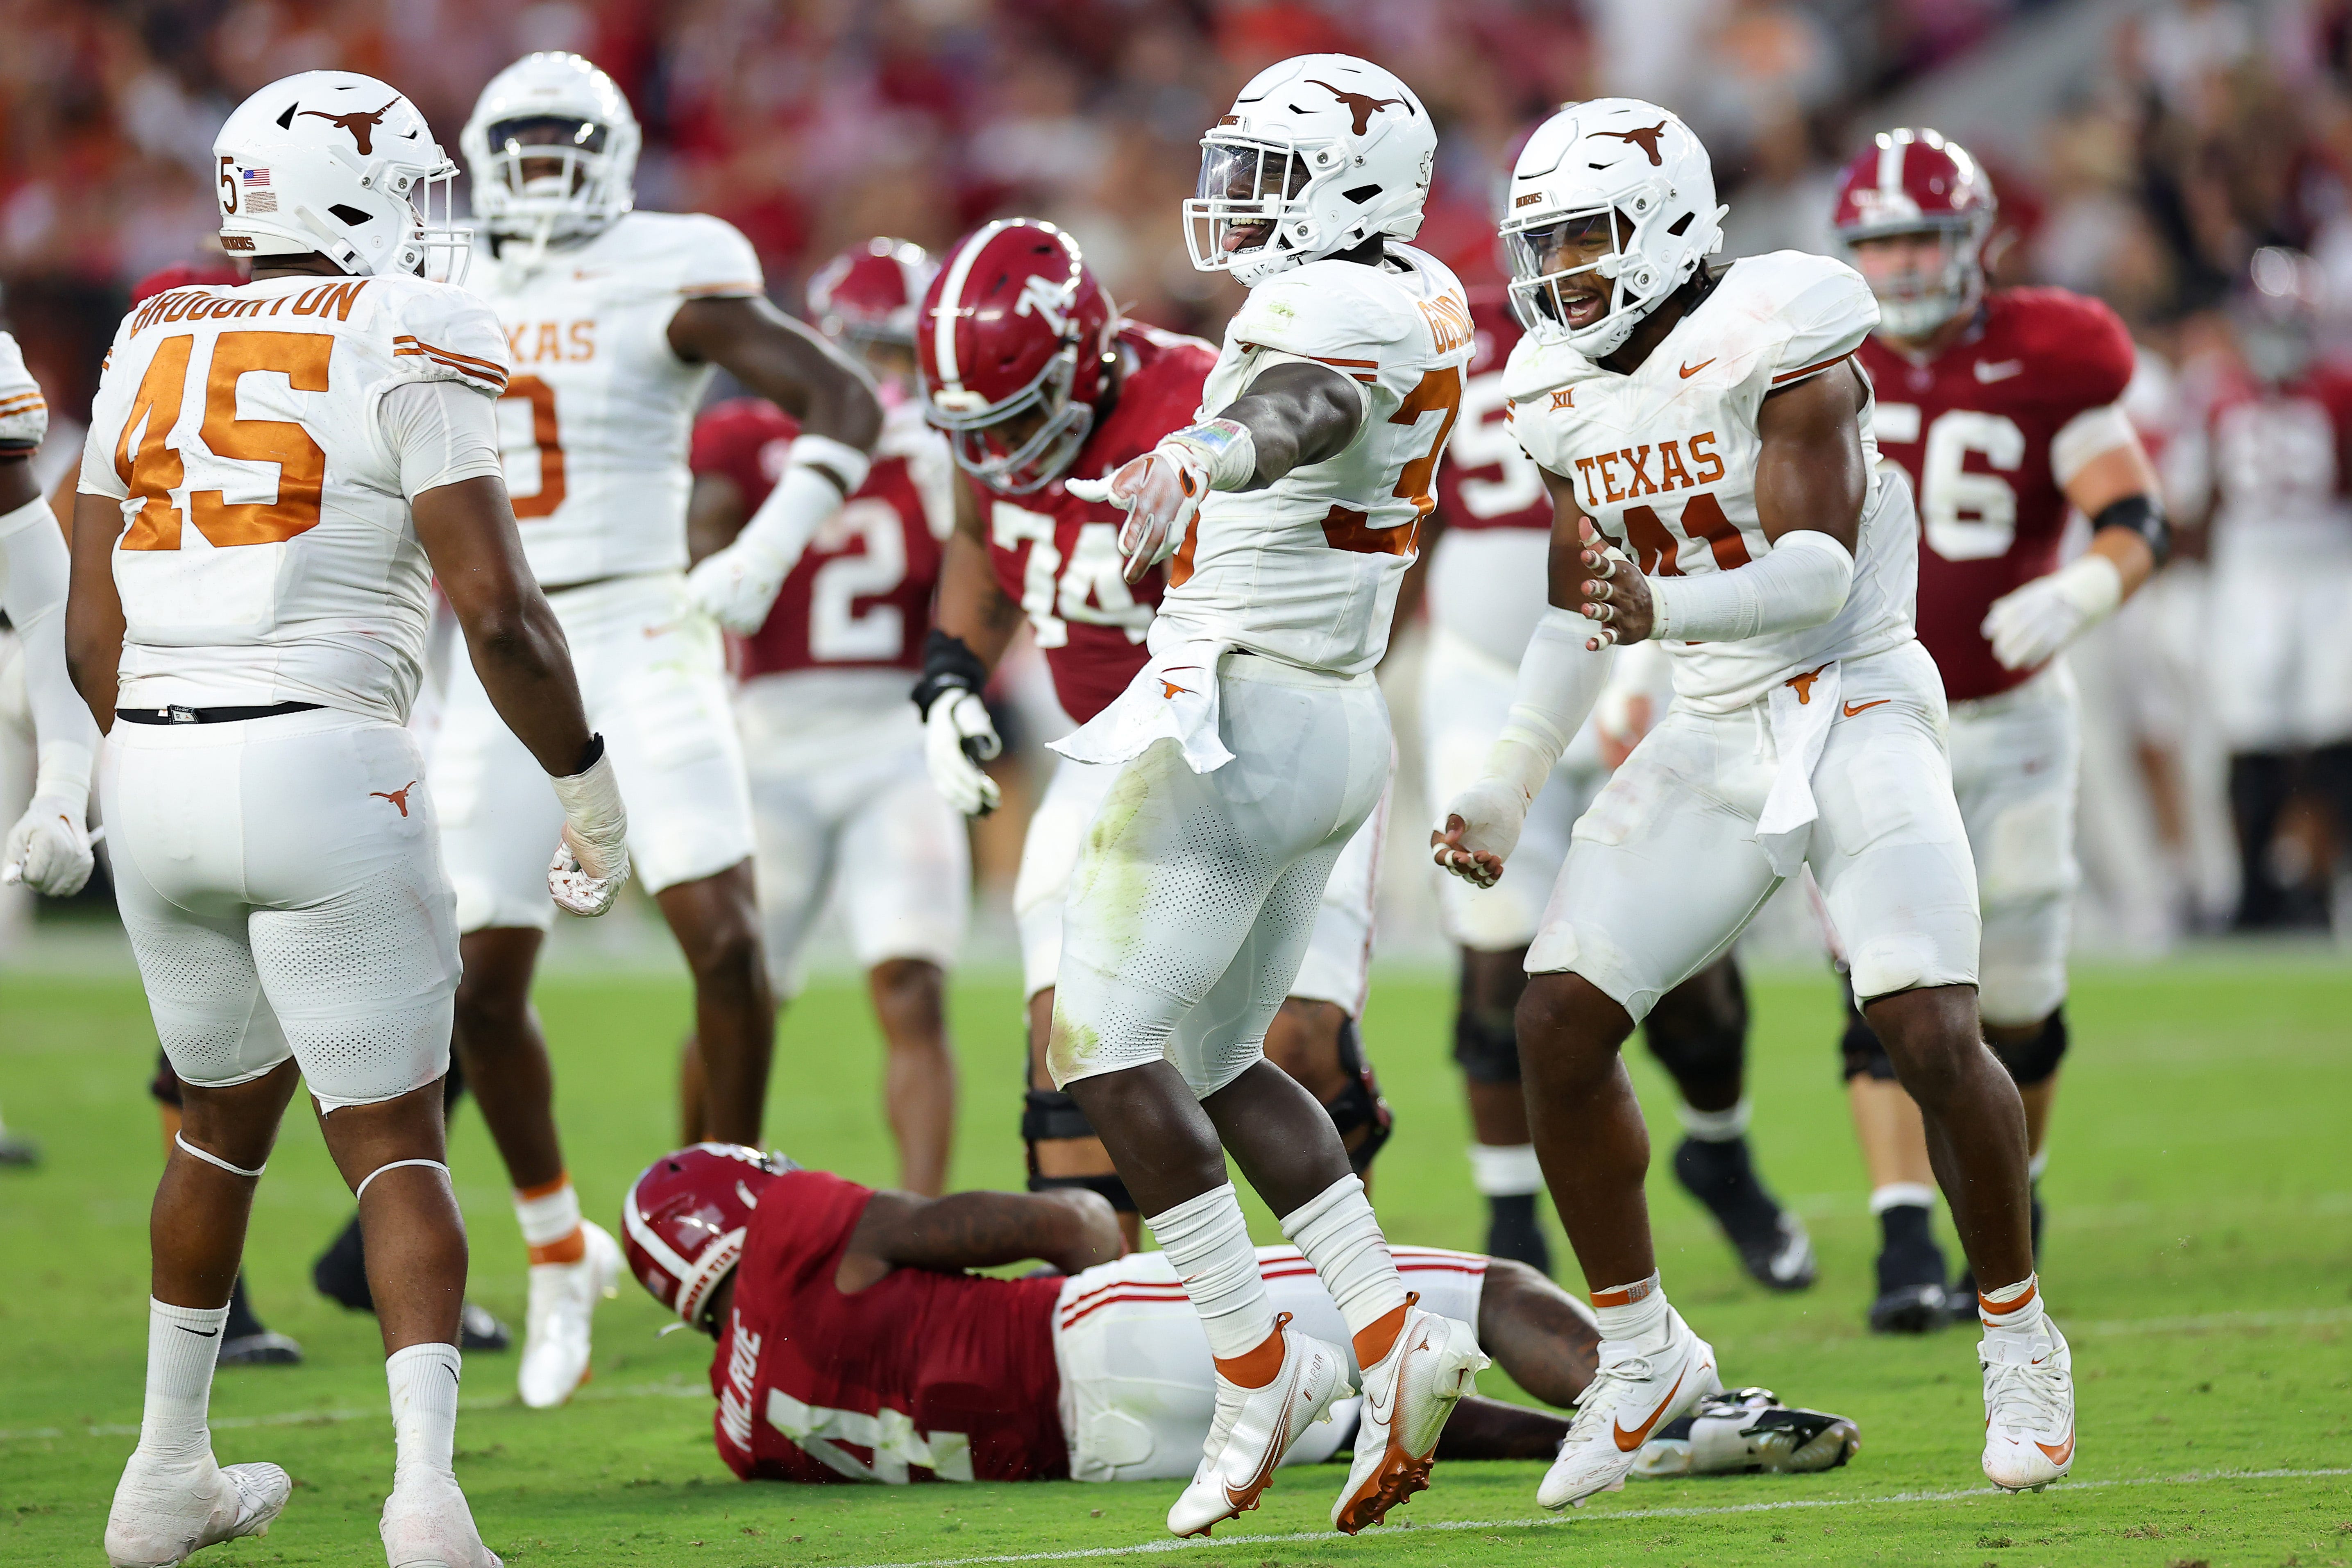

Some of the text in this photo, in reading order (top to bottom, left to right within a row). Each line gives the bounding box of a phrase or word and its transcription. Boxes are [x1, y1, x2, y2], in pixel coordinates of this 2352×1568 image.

[130, 280, 370, 340] BROUGHTON
[502, 320, 600, 364] XAS
[115, 331, 335, 551] 45
[1575, 431, 1725, 507] TEXAS
[807, 497, 907, 661] 2
[990, 500, 1157, 650] 74
[1623, 492, 1753, 577] 41
[765, 1387, 975, 1484] 4
